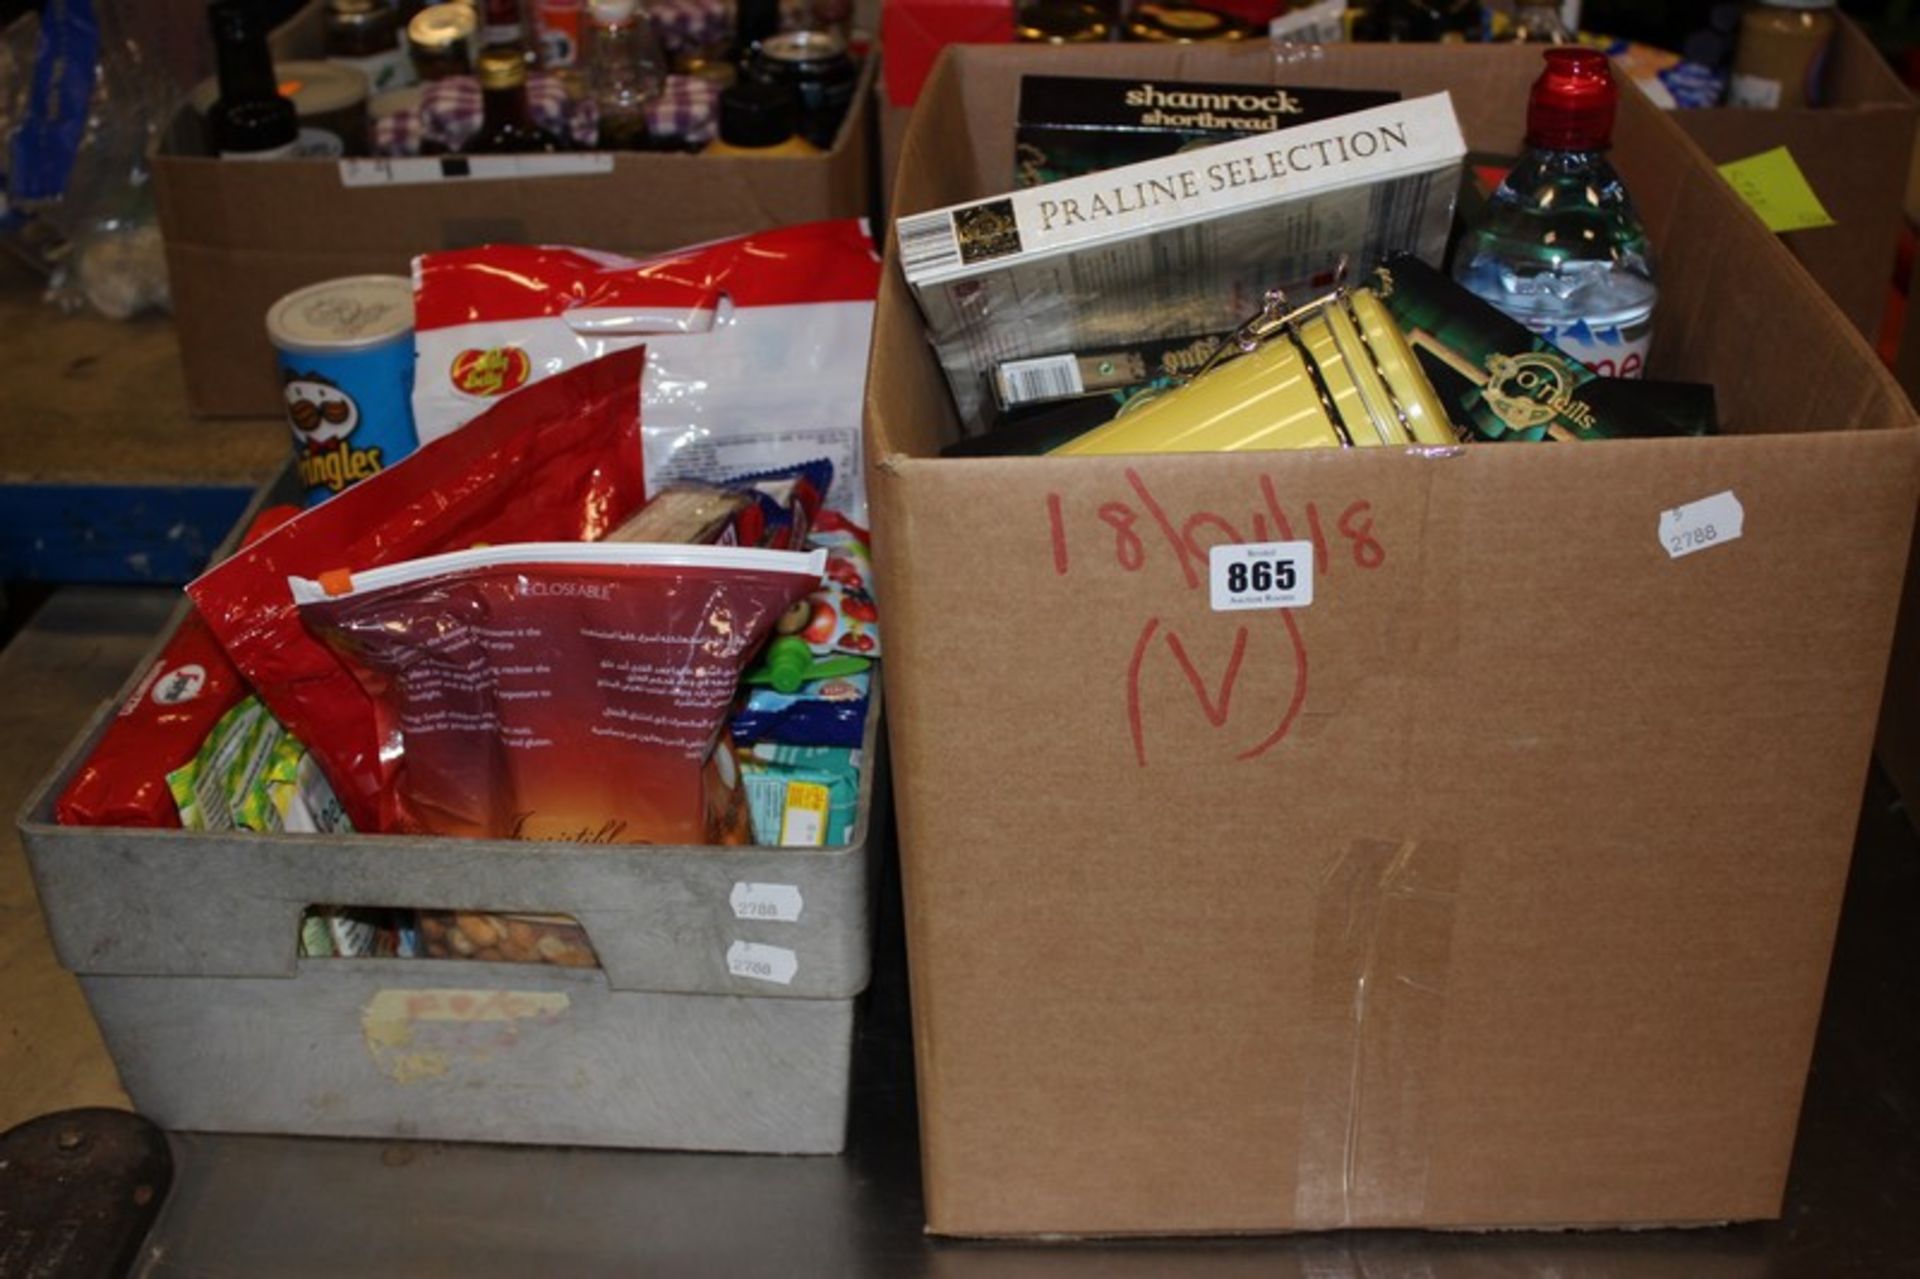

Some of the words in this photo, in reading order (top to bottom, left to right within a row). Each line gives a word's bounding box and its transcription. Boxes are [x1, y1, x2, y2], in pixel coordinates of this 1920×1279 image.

[1124, 84, 1303, 115] shamrock
[1140, 112, 1279, 132] shortbread
[1038, 170, 1200, 232] PRALINE
[1207, 121, 1409, 192] SELECTION
[300, 442, 382, 490] ringles
[1669, 524, 1718, 553] 2788
[1228, 559, 1297, 594] 865
